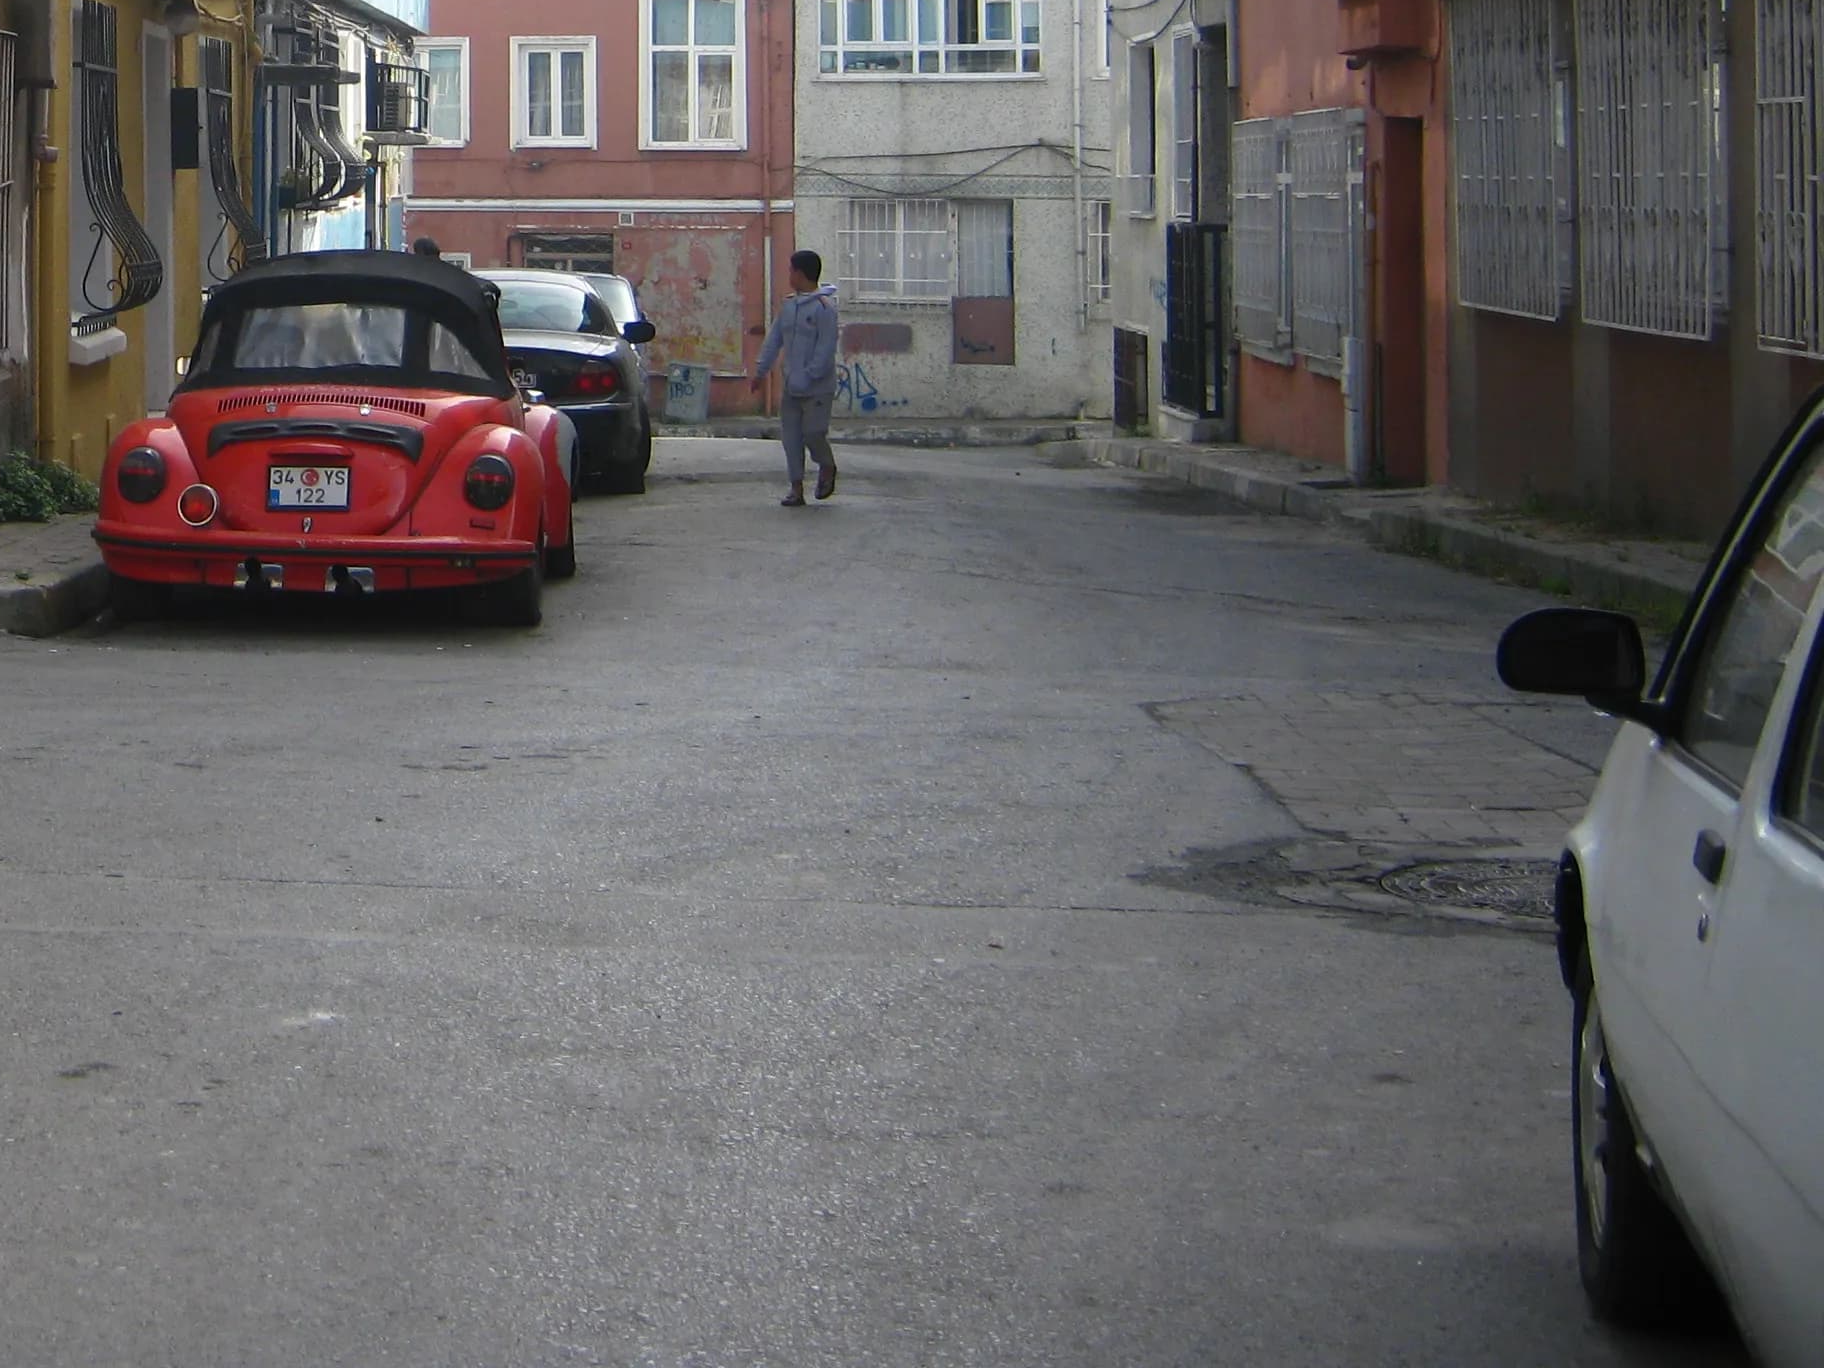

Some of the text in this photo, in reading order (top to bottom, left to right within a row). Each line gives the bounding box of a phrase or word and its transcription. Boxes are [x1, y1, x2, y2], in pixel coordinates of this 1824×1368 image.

[273, 470, 345, 485] 34 YS
[296, 488, 325, 503] 122
